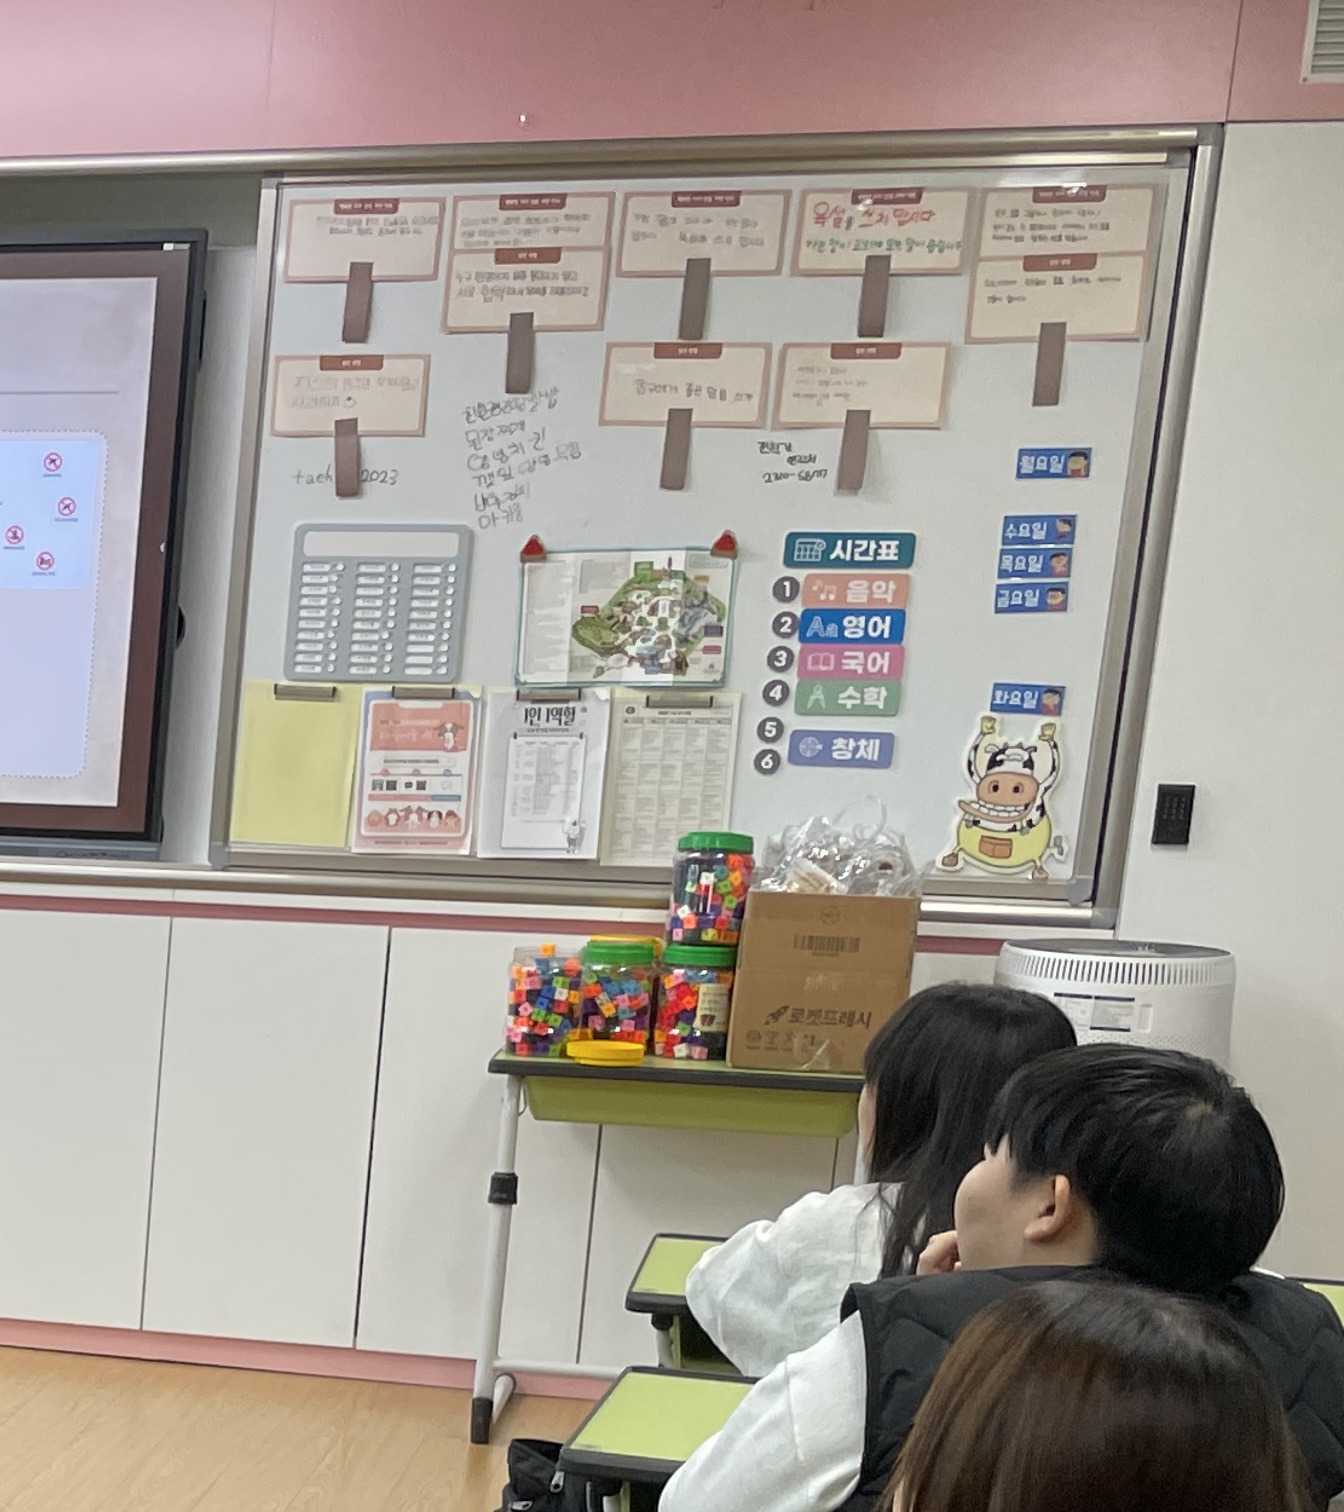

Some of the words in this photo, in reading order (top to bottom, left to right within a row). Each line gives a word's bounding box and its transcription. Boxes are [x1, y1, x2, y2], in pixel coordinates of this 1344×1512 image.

[1019, 454, 1065, 474] 월요일
[361, 468, 399, 486] 2023
[1004, 522, 1048, 540] 수요일
[829, 539, 900, 561] 시간표
[1000, 554, 1043, 573] 목요일
[782, 581, 791, 598] 1
[846, 580, 897, 604] 음악
[997, 589, 1040, 608] 금요일
[780, 616, 792, 634] 2
[842, 615, 891, 639] 영어
[774, 651, 788, 667] 3
[841, 651, 890, 675] 국어
[768, 685, 783, 701] 4
[837, 686, 888, 710] 수학
[992, 690, 1039, 709] 화요일
[764, 721, 777, 738] 5
[831, 737, 881, 762] 창체
[760, 753, 774, 770] 6
[788, 1007, 872, 1029] 로켓프레시
